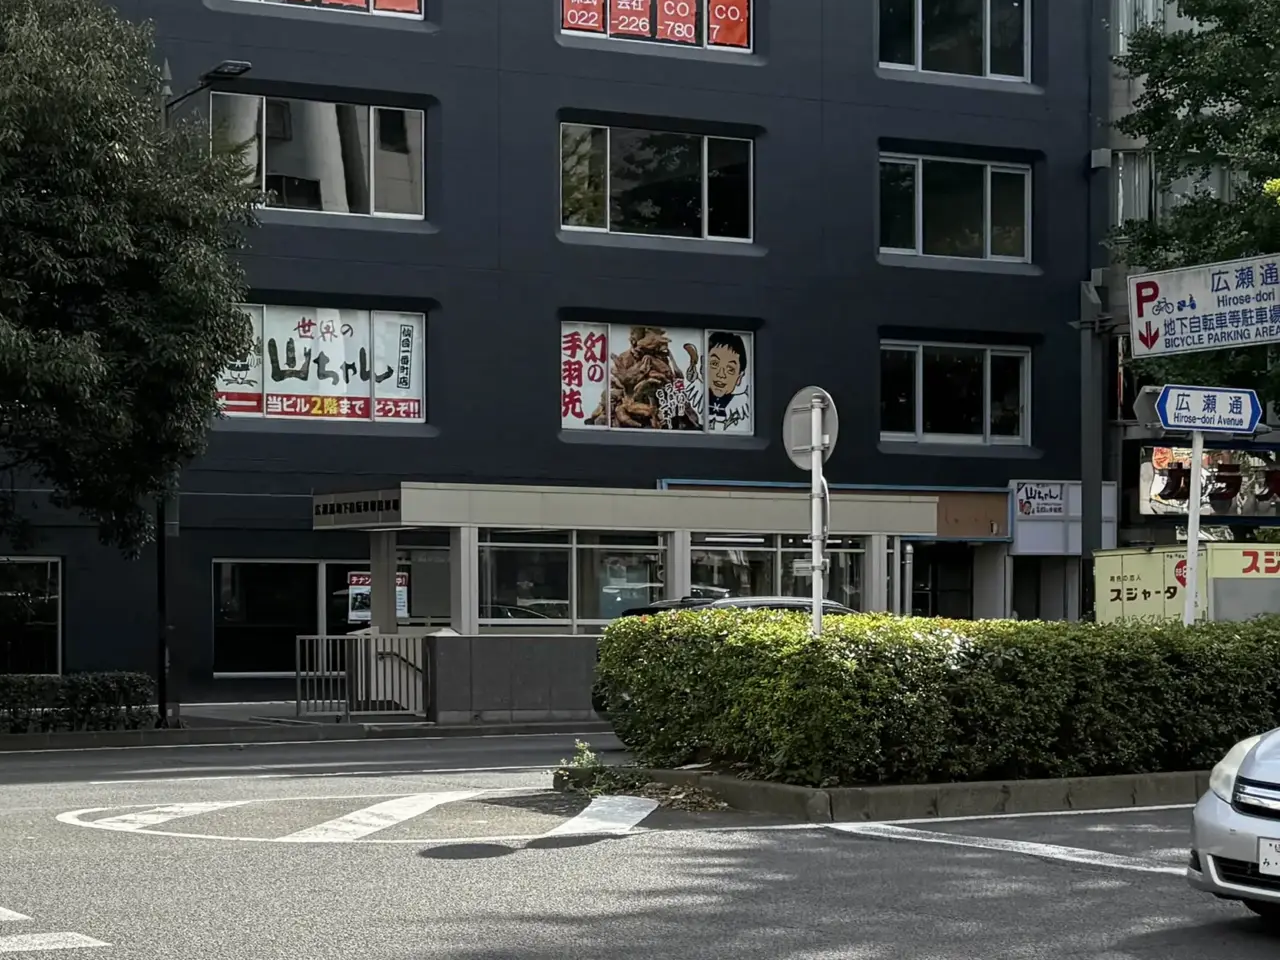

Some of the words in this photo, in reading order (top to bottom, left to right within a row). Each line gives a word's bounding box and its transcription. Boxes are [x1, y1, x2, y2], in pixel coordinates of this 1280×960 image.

[1211, 263, 1280, 293] 広瀬通
[1136, 281, 1159, 318] P
[1217, 288, 1276, 308] Hirose-dori
[294, 317, 353, 341] 世界の
[1163, 305, 1280, 337] 地下自転車等駐車場
[1164, 334, 1204, 349] BICYCLE
[1207, 328, 1251, 344] PARKING
[267, 338, 394, 386] 山ちゃん
[1176, 393, 1243, 415] 広瀬通
[1174, 413, 1215, 425] Hirose-dori
[1217, 415, 1244, 426] Avenue
[1025, 486, 1058, 501] 山ちゃん
[1110, 586, 1178, 602] スジャータ
